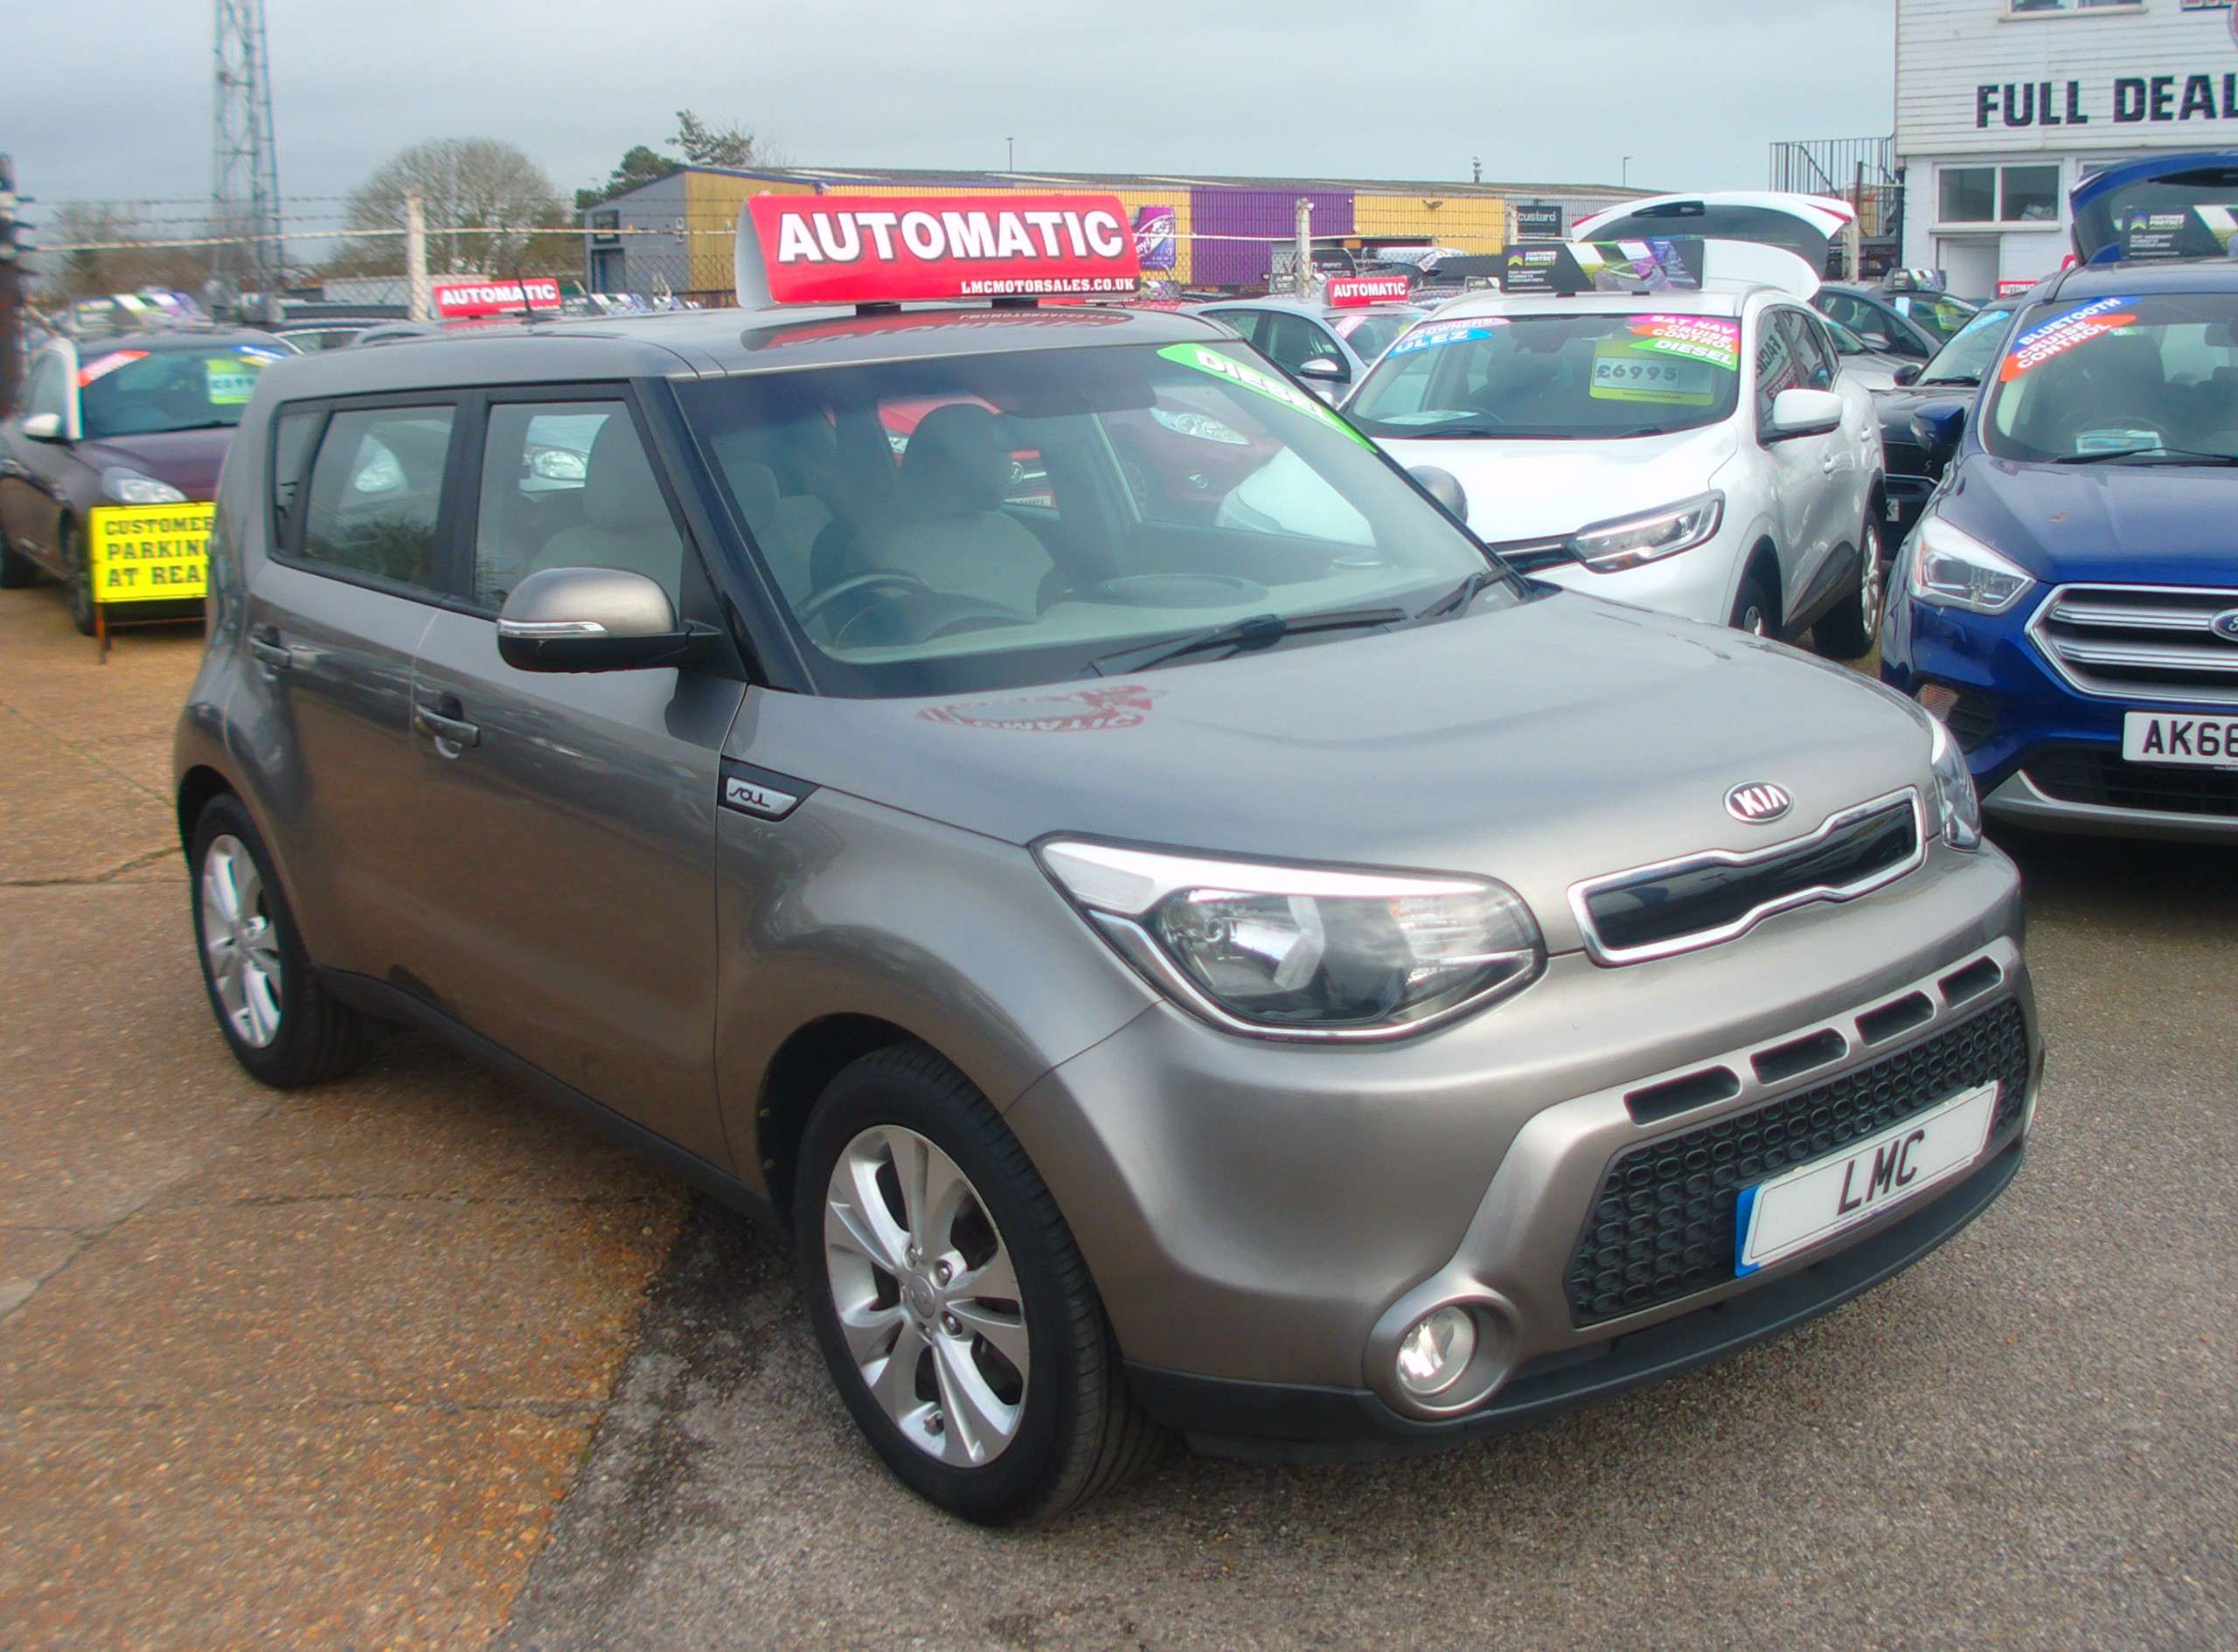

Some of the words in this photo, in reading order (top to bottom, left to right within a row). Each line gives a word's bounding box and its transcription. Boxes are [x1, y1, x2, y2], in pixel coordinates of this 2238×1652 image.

[1977, 80, 2088, 128] FULL
[2113, 73, 2238, 123] DEAL
[779, 210, 1124, 262] AUTOMATIC
[441, 285, 556, 306] AUTOMATIC
[961, 278, 1135, 295] LMCMOTORSALES.CO.UK
[1333, 281, 1406, 298] AUTOMATIC
[1650, 315, 1692, 326] SAT
[1693, 320, 1736, 335] NAV
[1665, 324, 1734, 344] CRUISE
[2018, 298, 2122, 346] BLUETOOTH
[1396, 329, 1470, 352] ULEZ
[1651, 328, 1734, 353] CONTROL
[1654, 339, 1733, 365] DIESEL
[2016, 321, 2092, 360] CRUISE
[2016, 323, 2113, 369] CONTROL
[1596, 364, 1678, 382] £6995
[108, 567, 139, 587] AT
[150, 565, 206, 585] REA
[1734, 784, 1789, 816] KIA
[1837, 1129, 1925, 1216] LMC
